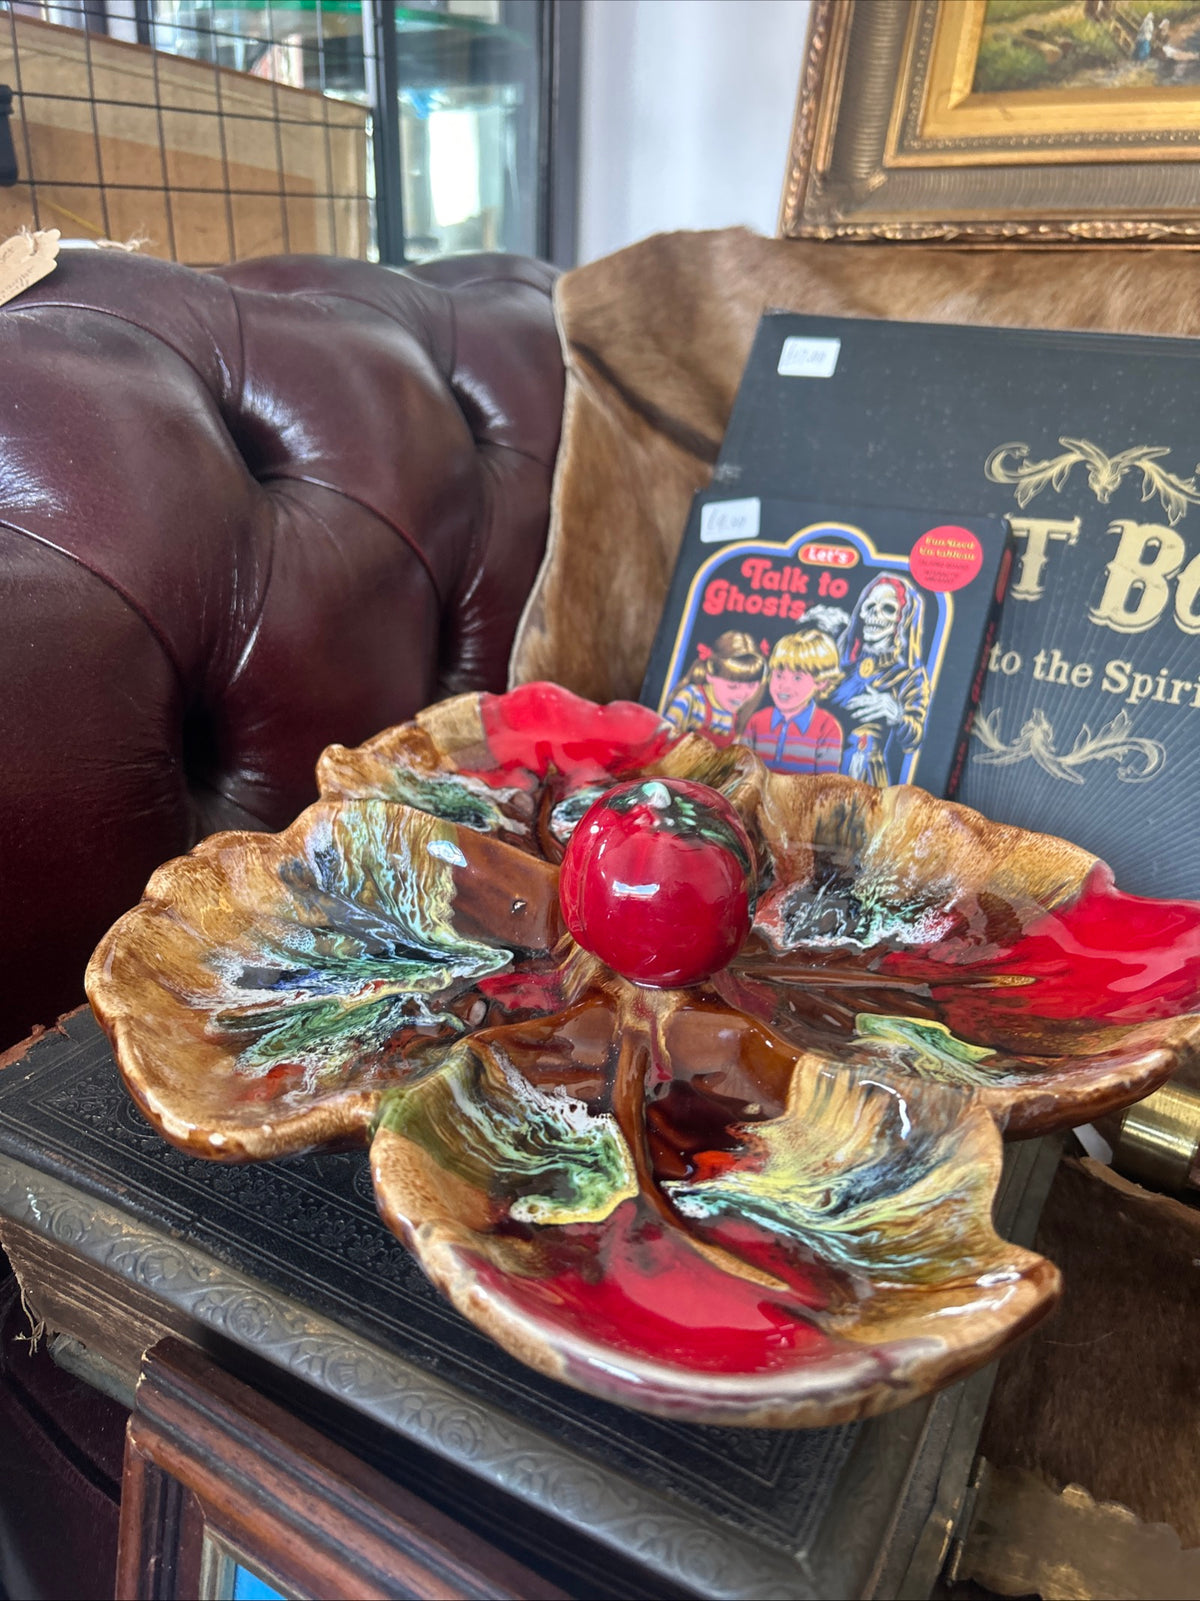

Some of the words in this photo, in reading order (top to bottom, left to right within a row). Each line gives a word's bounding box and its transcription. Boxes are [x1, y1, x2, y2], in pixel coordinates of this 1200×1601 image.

[808, 545, 849, 565] Let's
[740, 557, 810, 594] Talk
[817, 571, 849, 599] to
[702, 578, 806, 621] Ghosts
[987, 641, 1022, 675] to
[1033, 649, 1094, 688] the
